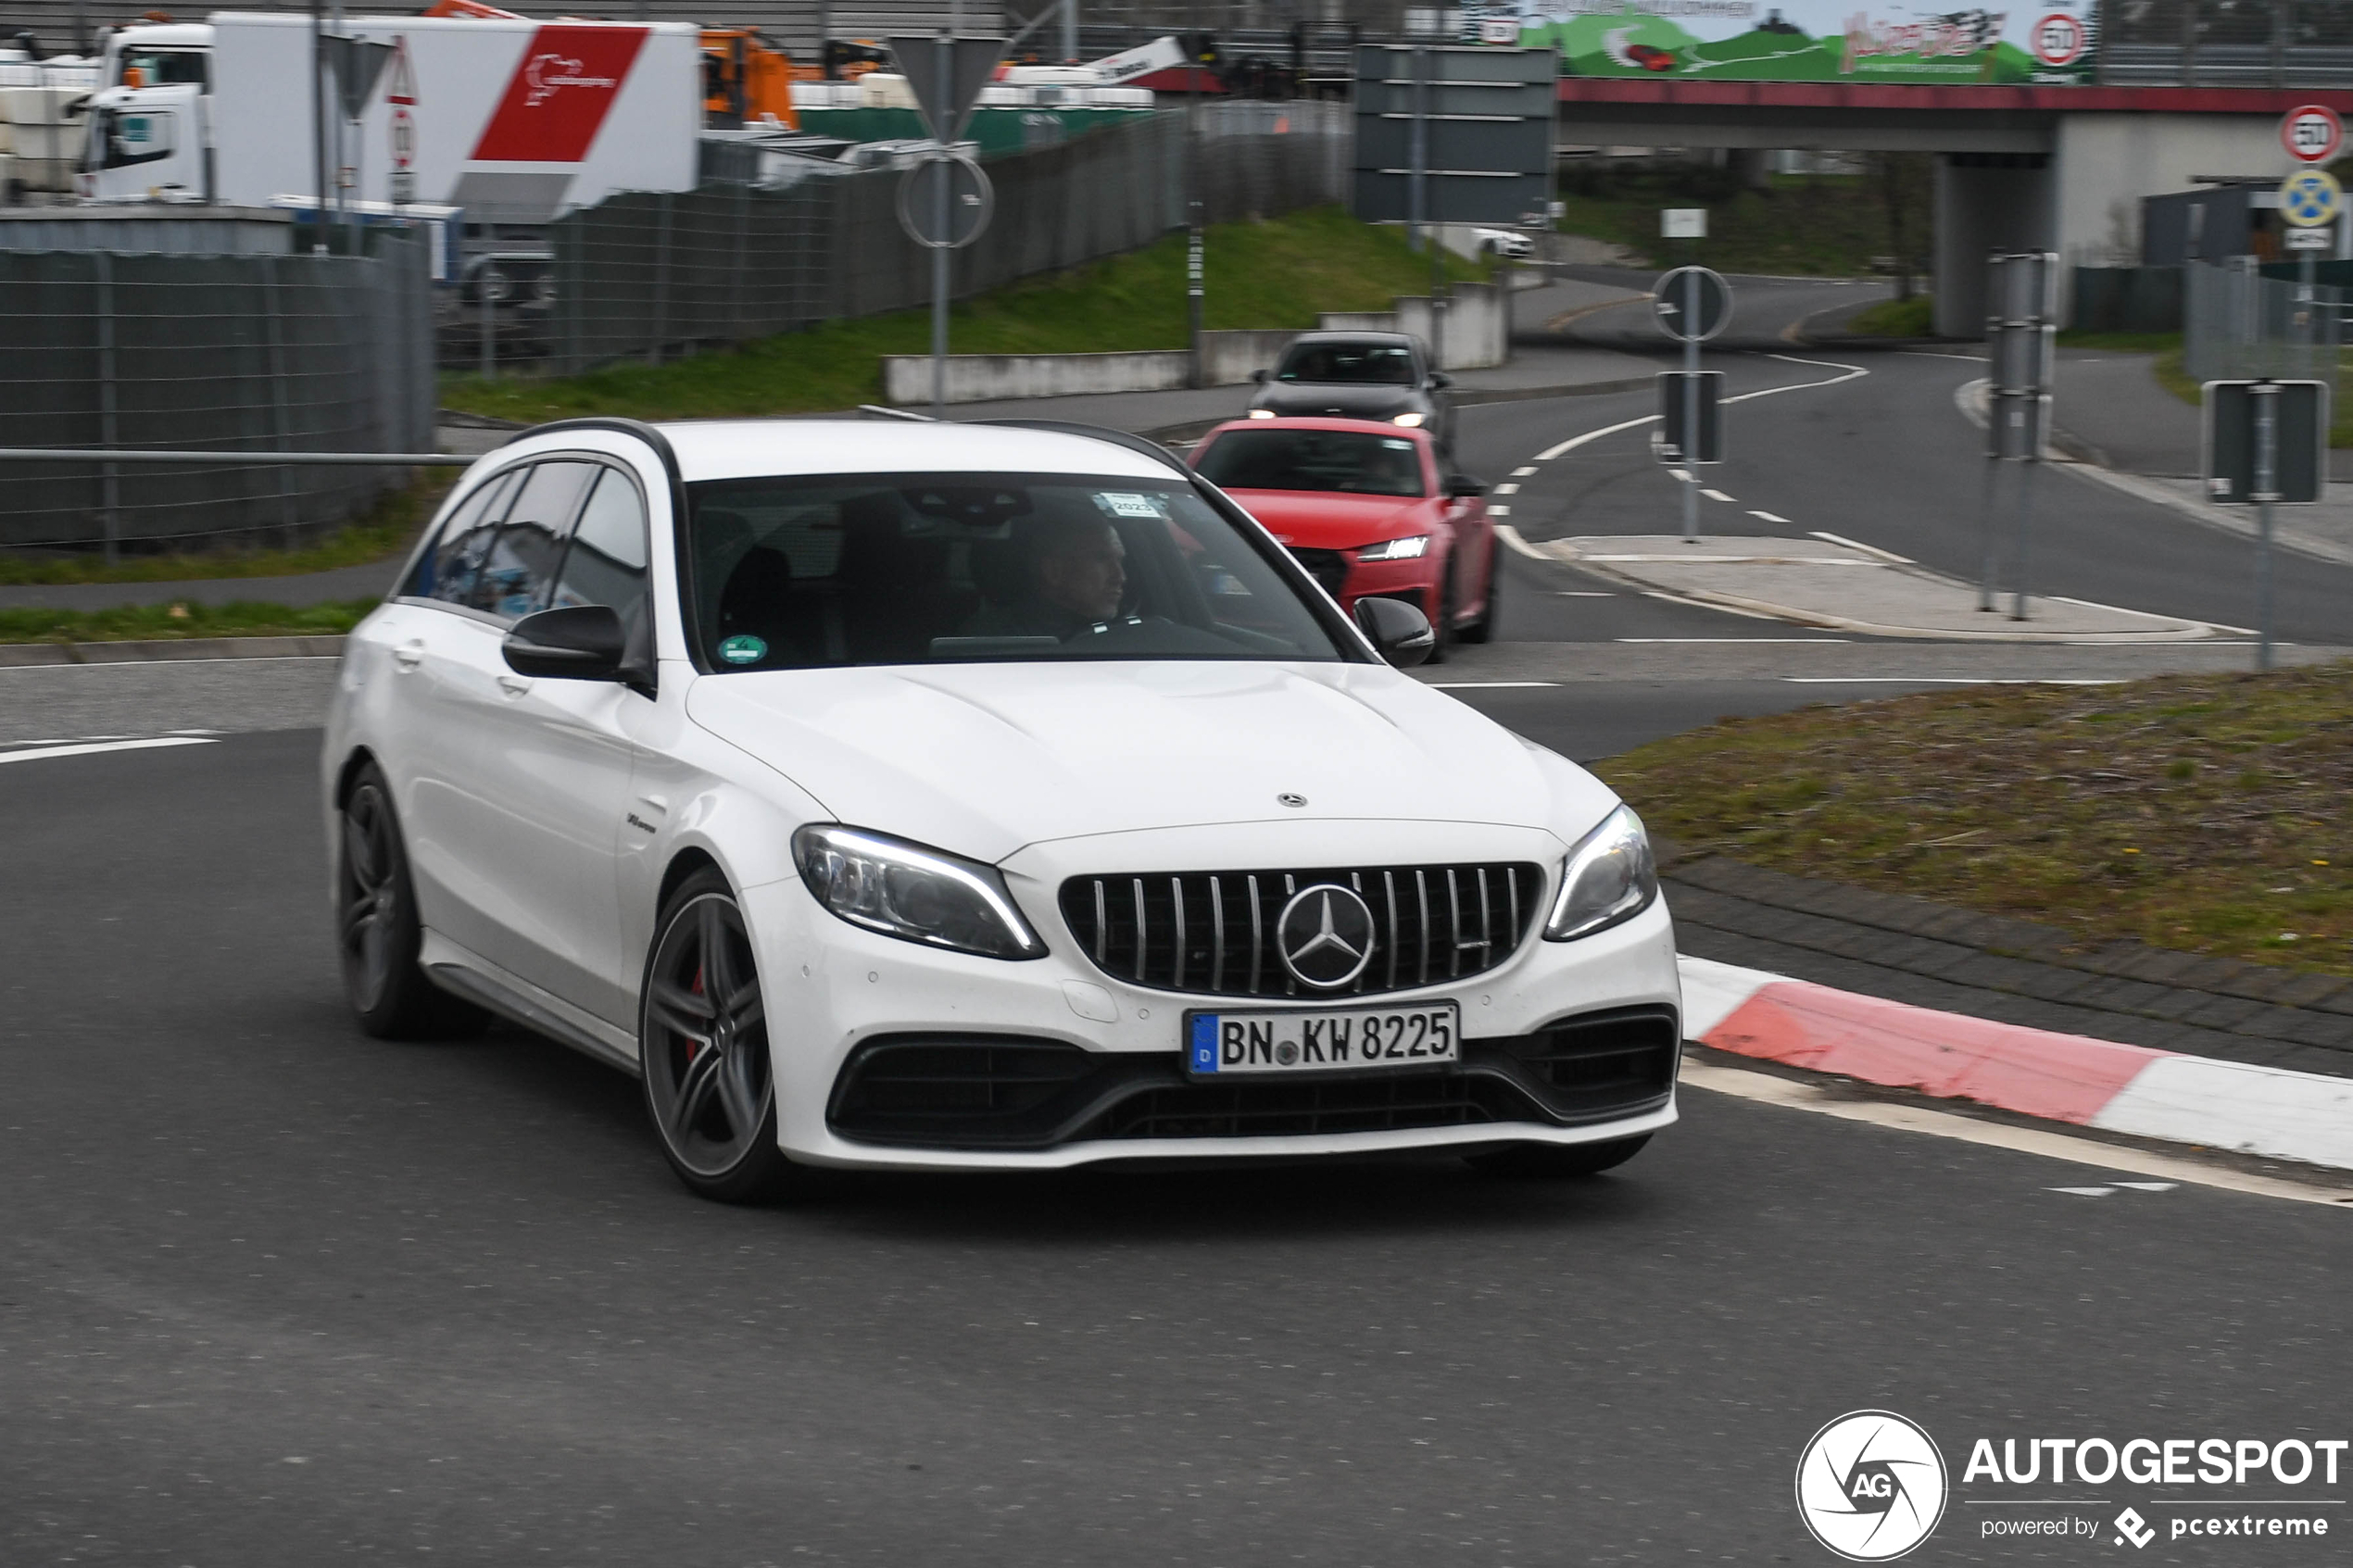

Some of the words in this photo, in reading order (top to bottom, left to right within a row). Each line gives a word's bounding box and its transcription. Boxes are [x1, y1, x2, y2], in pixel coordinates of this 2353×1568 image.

[2293, 122, 2329, 145] 50
[1115, 503, 1151, 511] 2023
[737, 639, 749, 649] 4
[1222, 1021, 1273, 1064] BN
[1303, 1018, 1351, 1062] KW
[1362, 1012, 1449, 1060] 8225
[1200, 1049, 1211, 1062] D
